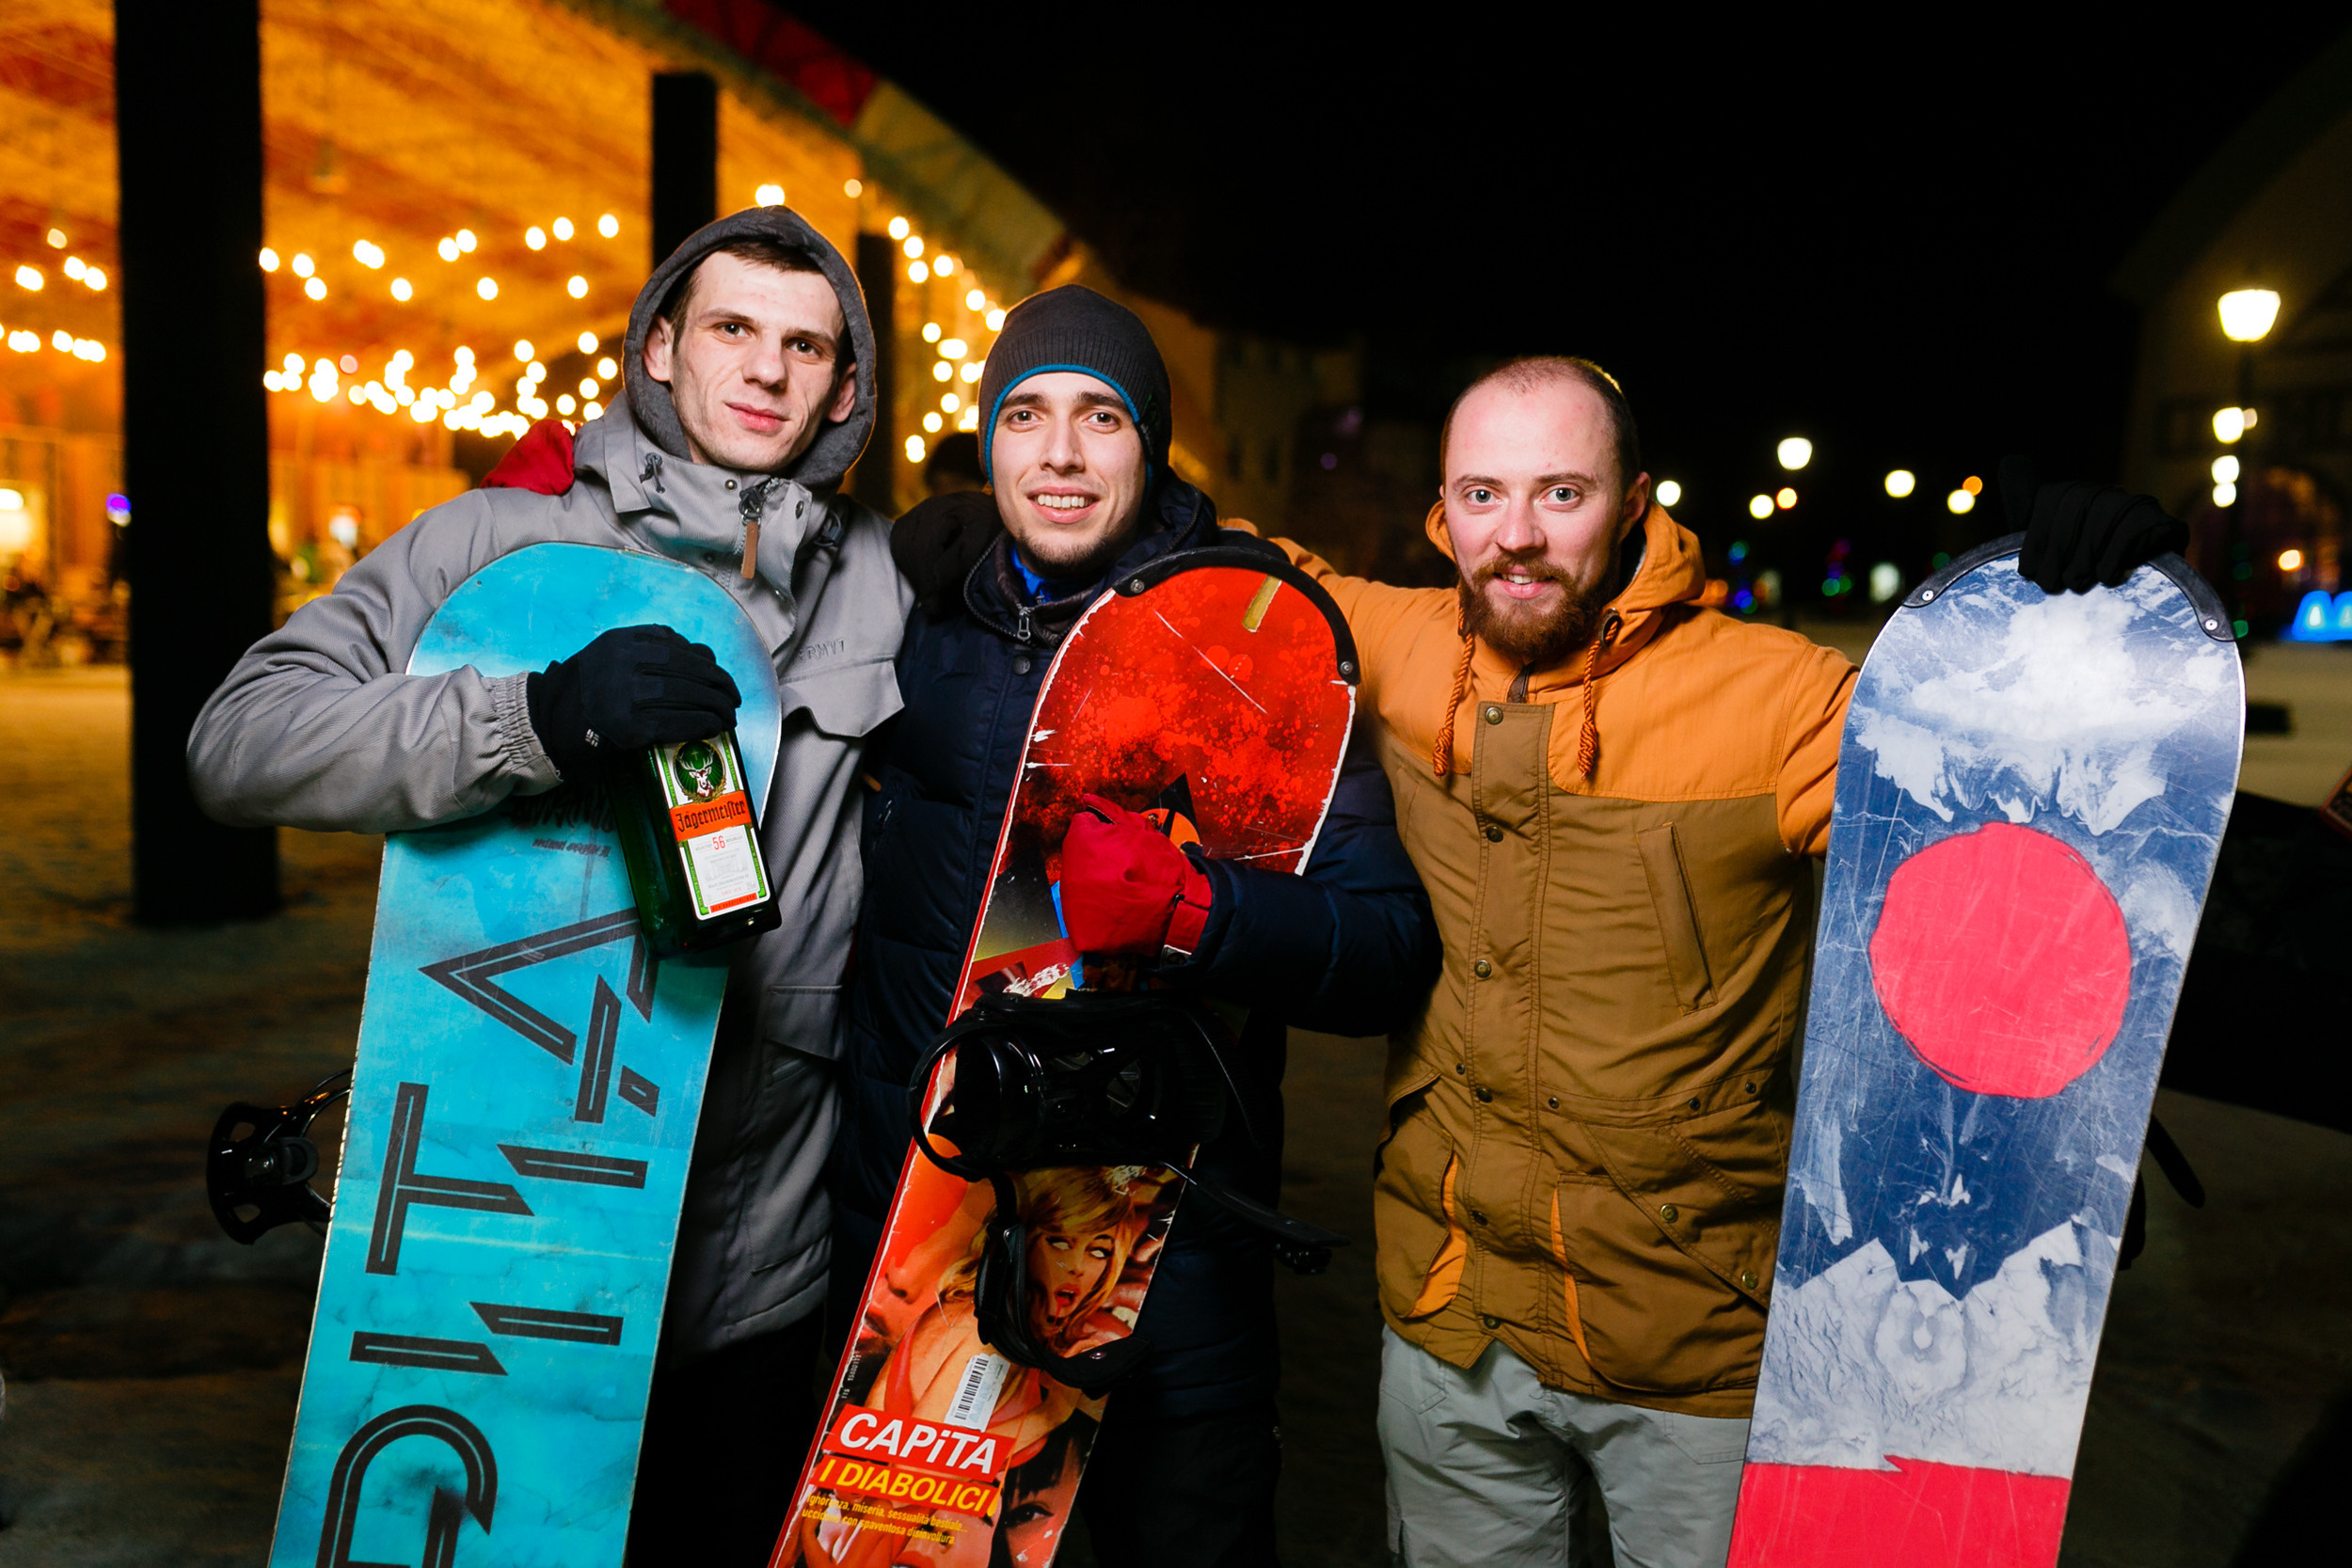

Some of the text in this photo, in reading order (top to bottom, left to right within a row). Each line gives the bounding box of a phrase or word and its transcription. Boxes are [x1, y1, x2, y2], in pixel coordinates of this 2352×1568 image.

[675, 800, 746, 832] Jägermeister
[712, 835, 726, 850] 56
[840, 1413, 996, 1474] CAPiTA
[818, 1459, 990, 1512] I DIABOLICI
[842, 1515, 858, 1526] con
[860, 1519, 906, 1535] spaventosa
